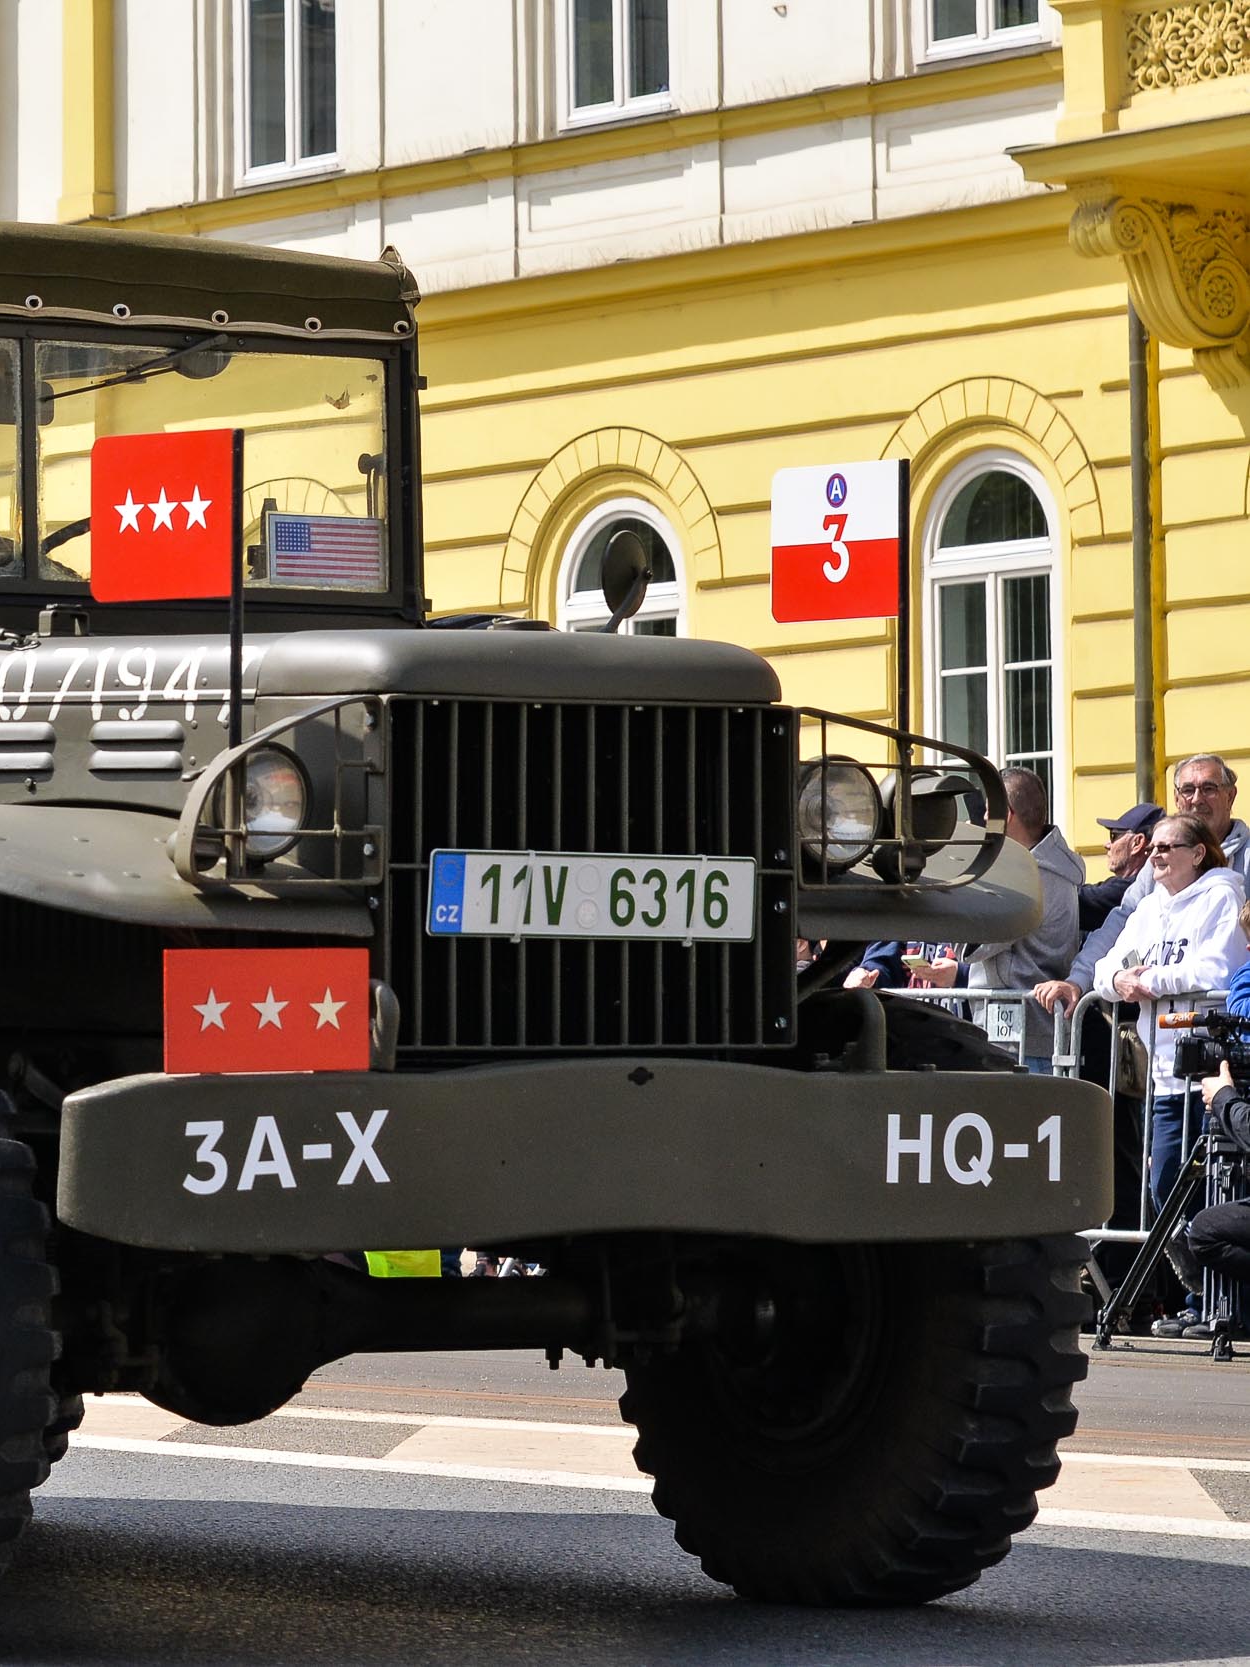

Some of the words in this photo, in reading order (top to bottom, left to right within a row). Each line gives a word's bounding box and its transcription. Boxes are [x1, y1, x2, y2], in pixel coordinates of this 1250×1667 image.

[830, 478, 843, 500] A
[822, 513, 850, 583] 3
[436, 904, 459, 922] CZ
[480, 863, 569, 925] 11V
[609, 867, 730, 929] 6316
[182, 1109, 391, 1195] 3A-X
[886, 1112, 1061, 1187] HQ-1
